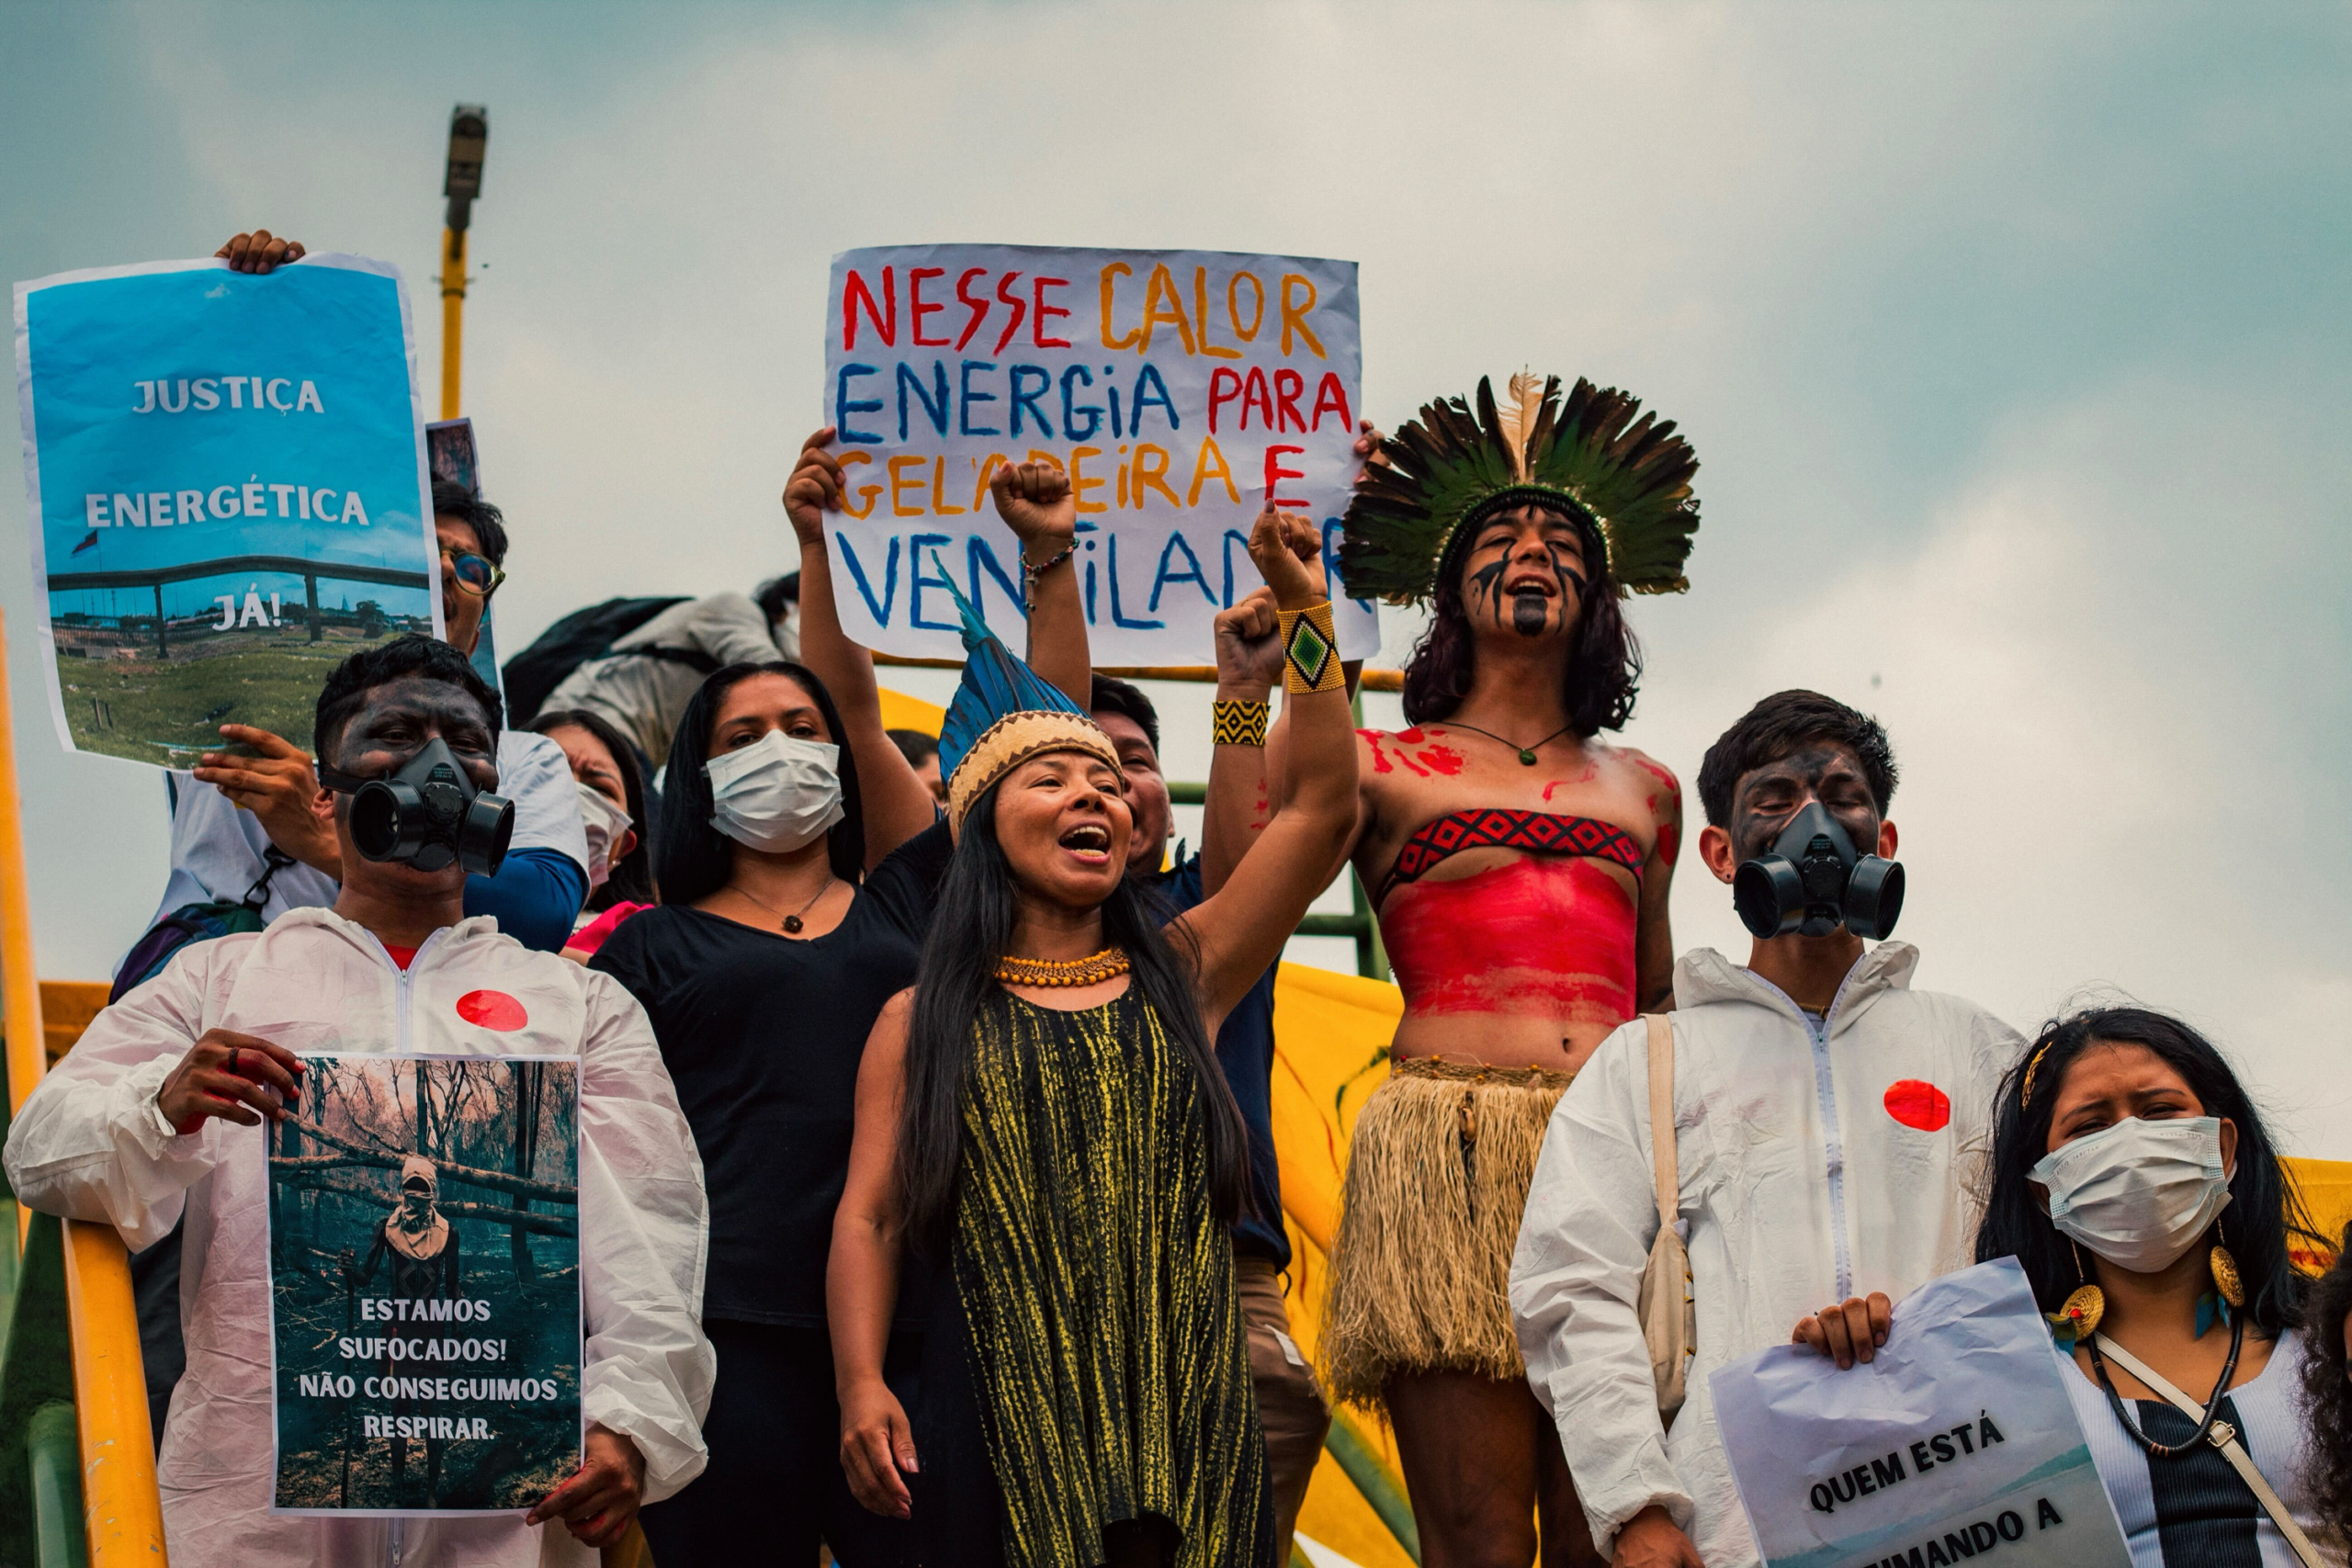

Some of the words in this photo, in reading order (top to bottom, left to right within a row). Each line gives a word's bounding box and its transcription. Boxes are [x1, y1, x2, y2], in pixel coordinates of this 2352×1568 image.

[843, 265, 1071, 355] NESSE
[1101, 263, 1327, 358] CALOR
[132, 376, 324, 416] JUSTIÇA
[1208, 367, 1352, 434] PARA
[1265, 446, 1310, 508] E
[86, 474, 369, 527] ENERGÉTICA
[212, 583, 281, 631] JÁ!
[362, 1298, 491, 1322] ESTAMOS
[338, 1337, 506, 1361] SUFOCADOS!
[300, 1371, 356, 1398] NÃO
[365, 1377, 558, 1401] CONSEGUIMOS
[365, 1416, 495, 1441] RESPIRAR.
[1811, 1452, 1906, 1514] QUEM
[1909, 1409, 2005, 1473] ESTÁ
[2038, 1498, 2064, 1530] A
